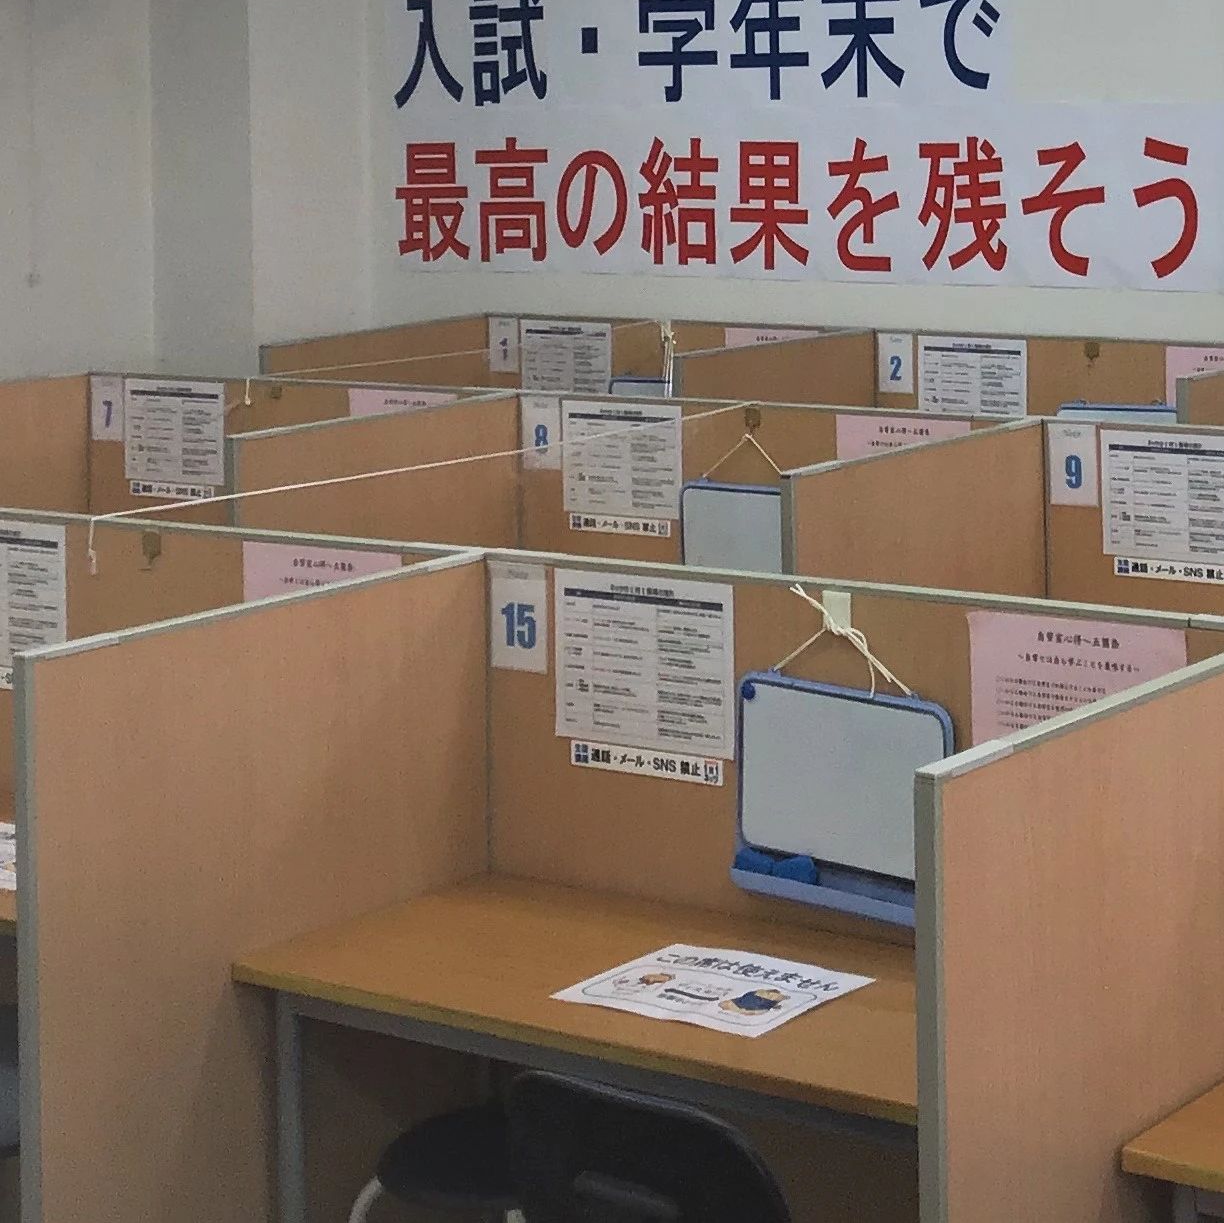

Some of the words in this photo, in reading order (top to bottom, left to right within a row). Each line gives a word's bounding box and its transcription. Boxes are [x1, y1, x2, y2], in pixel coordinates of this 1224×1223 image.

[889, 356, 902, 381] 2
[1065, 454, 1083, 489] 9
[501, 602, 536, 649] 15
